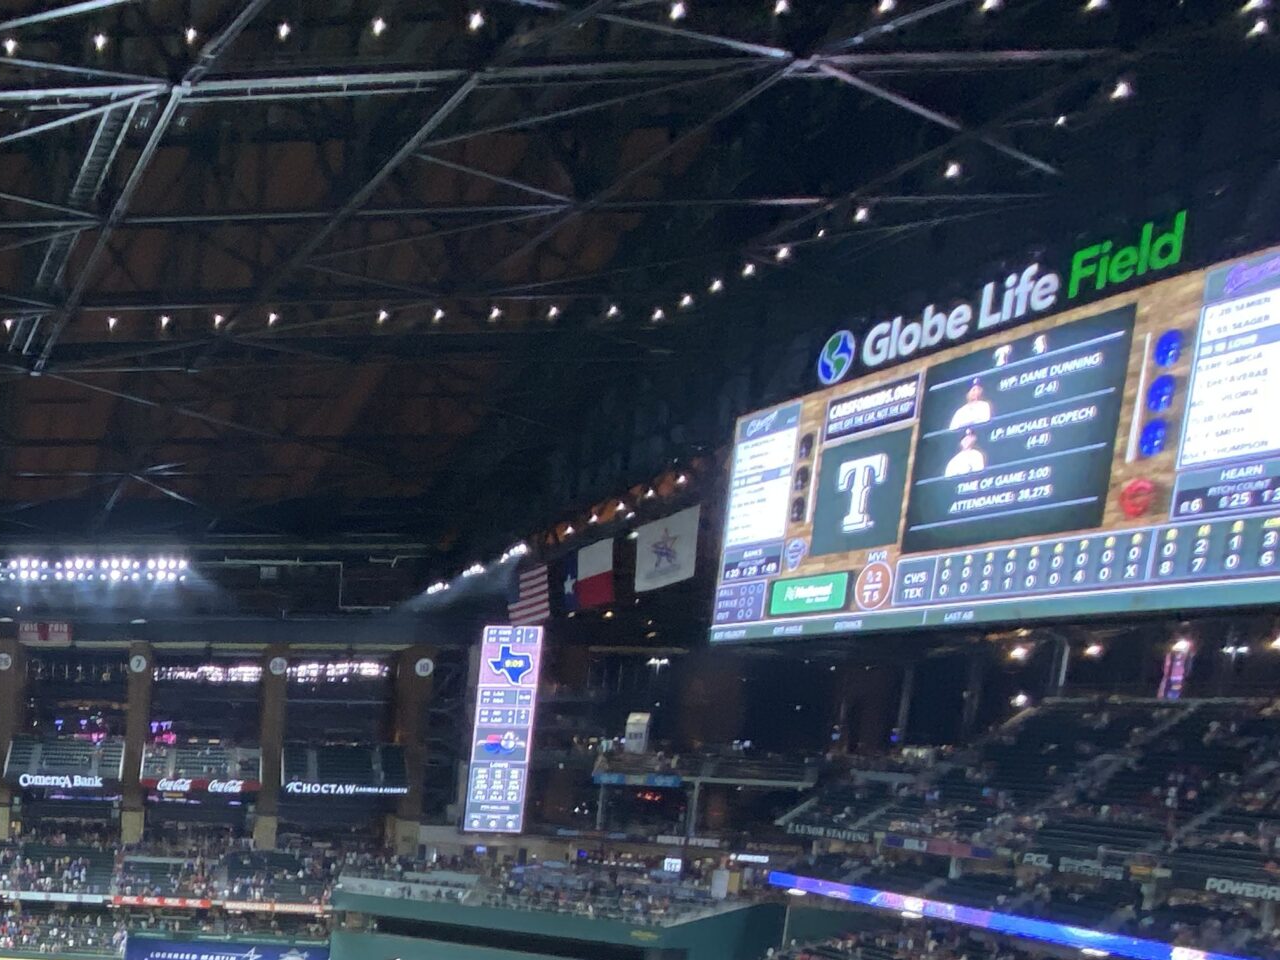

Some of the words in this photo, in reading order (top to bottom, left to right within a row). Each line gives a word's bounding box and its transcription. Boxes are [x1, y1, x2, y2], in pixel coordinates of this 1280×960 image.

[863, 303, 972, 366] Globe
[977, 262, 1060, 329] Life
[1068, 210, 1187, 298] Field
[1020, 367, 1047, 384] DANE
[1050, 353, 1102, 377] DUNNING
[1006, 417, 1050, 437] MICHAEL
[1050, 405, 1097, 426] KOPECH
[957, 480, 979, 494] TIME
[980, 478, 993, 489] OF
[995, 470, 1027, 486] GAME:
[1220, 464, 1263, 480] HEARN
[837, 453, 888, 533] T
[949, 491, 1015, 512] ATTENDANCE:
[867, 550, 887, 562] MVR
[904, 572, 928, 584] CWS
[942, 569, 952, 580] 0
[962, 567, 971, 578] 0
[983, 564, 993, 576] 0
[1005, 562, 1016, 573] 0
[1028, 559, 1039, 571] 0
[1052, 556, 1063, 568] 0
[1077, 553, 1089, 565] 0
[1103, 550, 1114, 562] 0
[1129, 546, 1141, 560] 0
[1163, 542, 1176, 557] 0
[1195, 539, 1208, 554] 2
[1230, 535, 1241, 550] 1
[1263, 531, 1278, 547] 3
[904, 587, 924, 599] TEX
[940, 584, 948, 595] 0
[960, 582, 970, 593] 0
[980, 580, 991, 591] 3
[1003, 579, 1012, 590] 1
[1026, 575, 1036, 587] 0
[1050, 573, 1060, 585] 0
[1073, 570, 1084, 582] 4
[1099, 568, 1110, 579] 0
[1125, 565, 1136, 578] X
[1160, 561, 1173, 575] 8
[1192, 557, 1206, 572] 7
[1225, 554, 1240, 569] 0
[1261, 551, 1274, 566] 6
[73, 775, 103, 787] Bank
[294, 782, 355, 795] CHOCTAW
[150, 951, 197, 960] LOCKHEED
